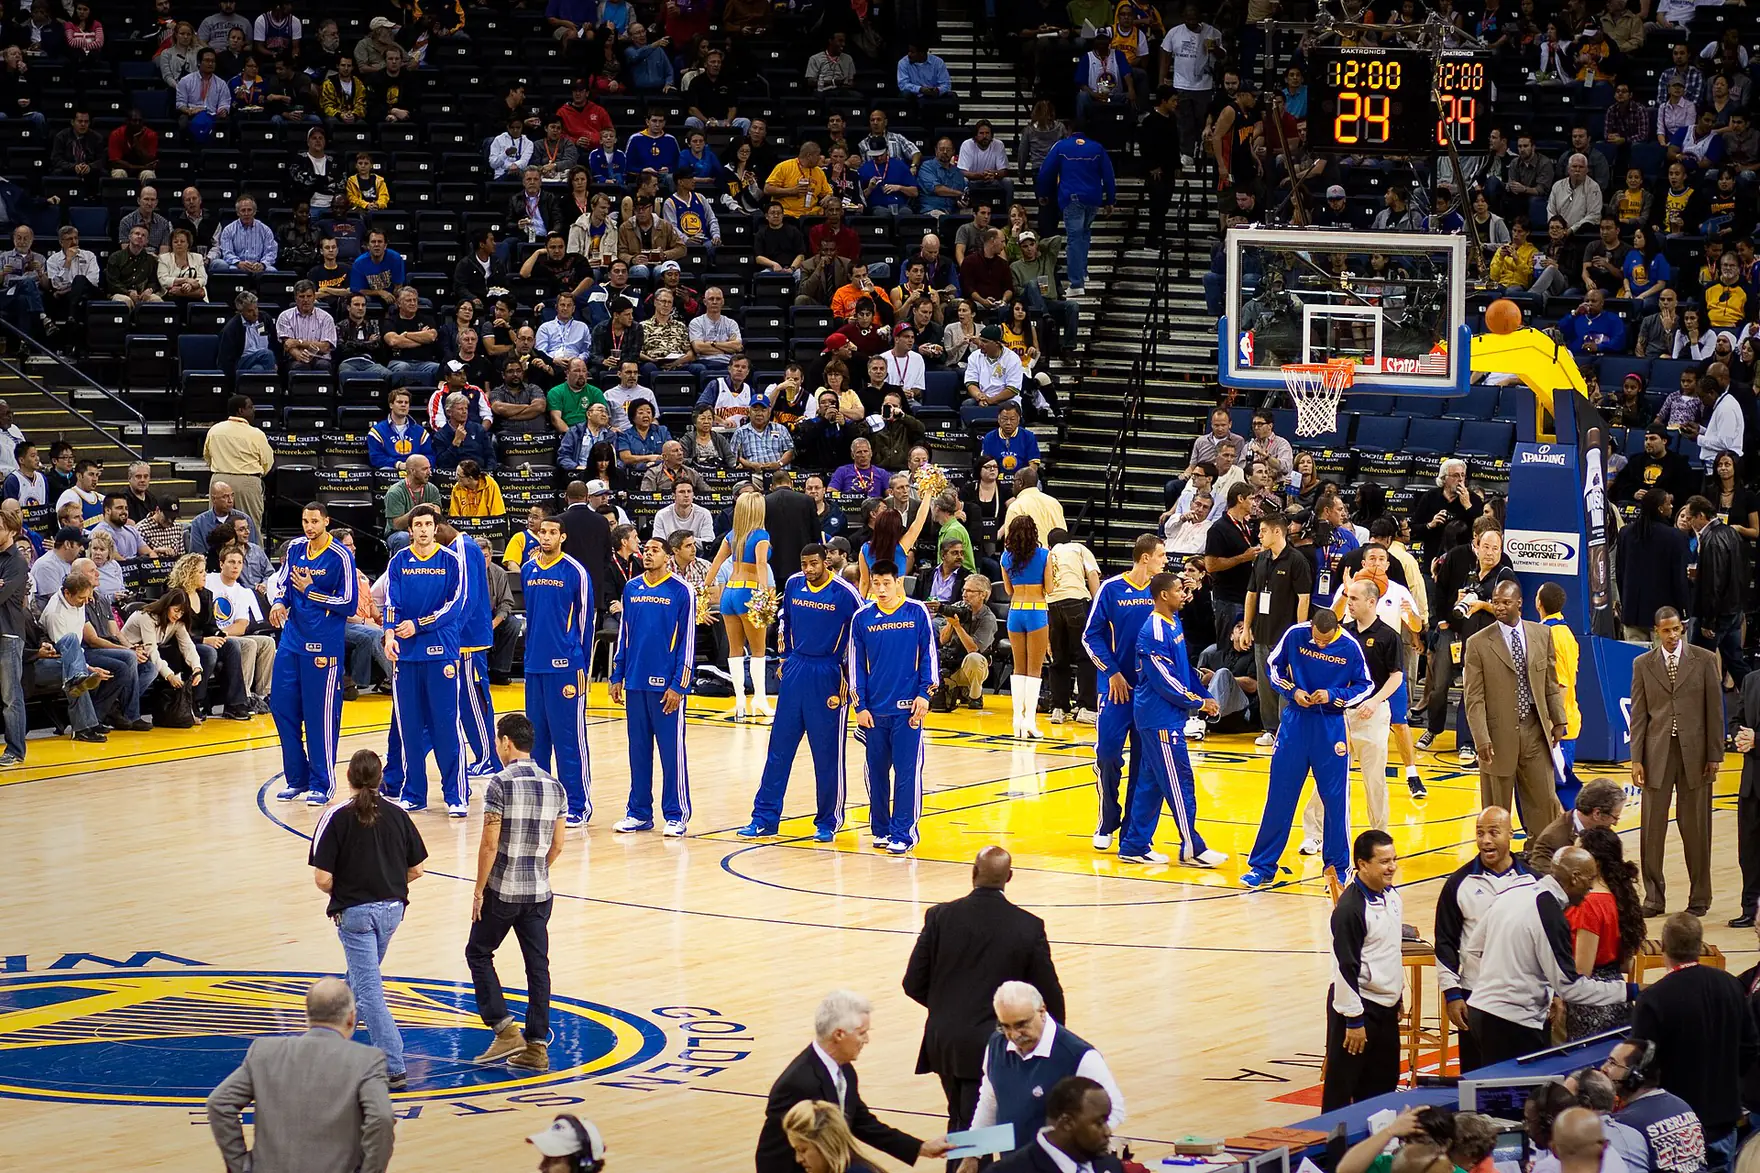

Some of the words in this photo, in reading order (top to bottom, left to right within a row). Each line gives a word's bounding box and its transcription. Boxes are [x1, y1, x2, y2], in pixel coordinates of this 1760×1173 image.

[1335, 60, 1401, 90] 12:00
[1438, 63, 1483, 91] 12:00
[1334, 92, 1390, 144] 24
[1437, 94, 1475, 146] 24
[321, 434, 345, 442] CACHE
[501, 434, 523, 442] CACHE
[505, 446, 554, 455] cachecreek.com
[1360, 452, 1384, 460] CACHE
[1415, 455, 1439, 464] CACHE
[1520, 452, 1566, 466] SPALDING
[1470, 458, 1494, 466] CACHE
[437, 469, 457, 477] CACH
[1360, 466, 1407, 474] cachecreek.com
[1471, 472, 1511, 481] cachecreek.co
[319, 484, 369, 493] cachecreek.com
[501, 483, 551, 491] cachecreek.com
[447, 518, 471, 526] CACHE
[481, 517, 506, 526] CREEK
[470, 531, 503, 539] creek.com
[1510, 541, 1558, 552] comcast
[1517, 550, 1563, 560] SPORTSNET
[292, 564, 327, 576] WARORS
[401, 567, 447, 576] WARRIORS
[527, 579, 564, 588] WARRIORS
[630, 596, 671, 605] WARRIORS
[791, 597, 836, 612] WARRIORS
[1117, 598, 1155, 607] WARRIO
[867, 621, 915, 633] WARRIORS
[1299, 646, 1347, 665] WARRIORS
[593, 1005, 755, 1092] GOLDEN
[1645, 1111, 1700, 1138] STERLIN
